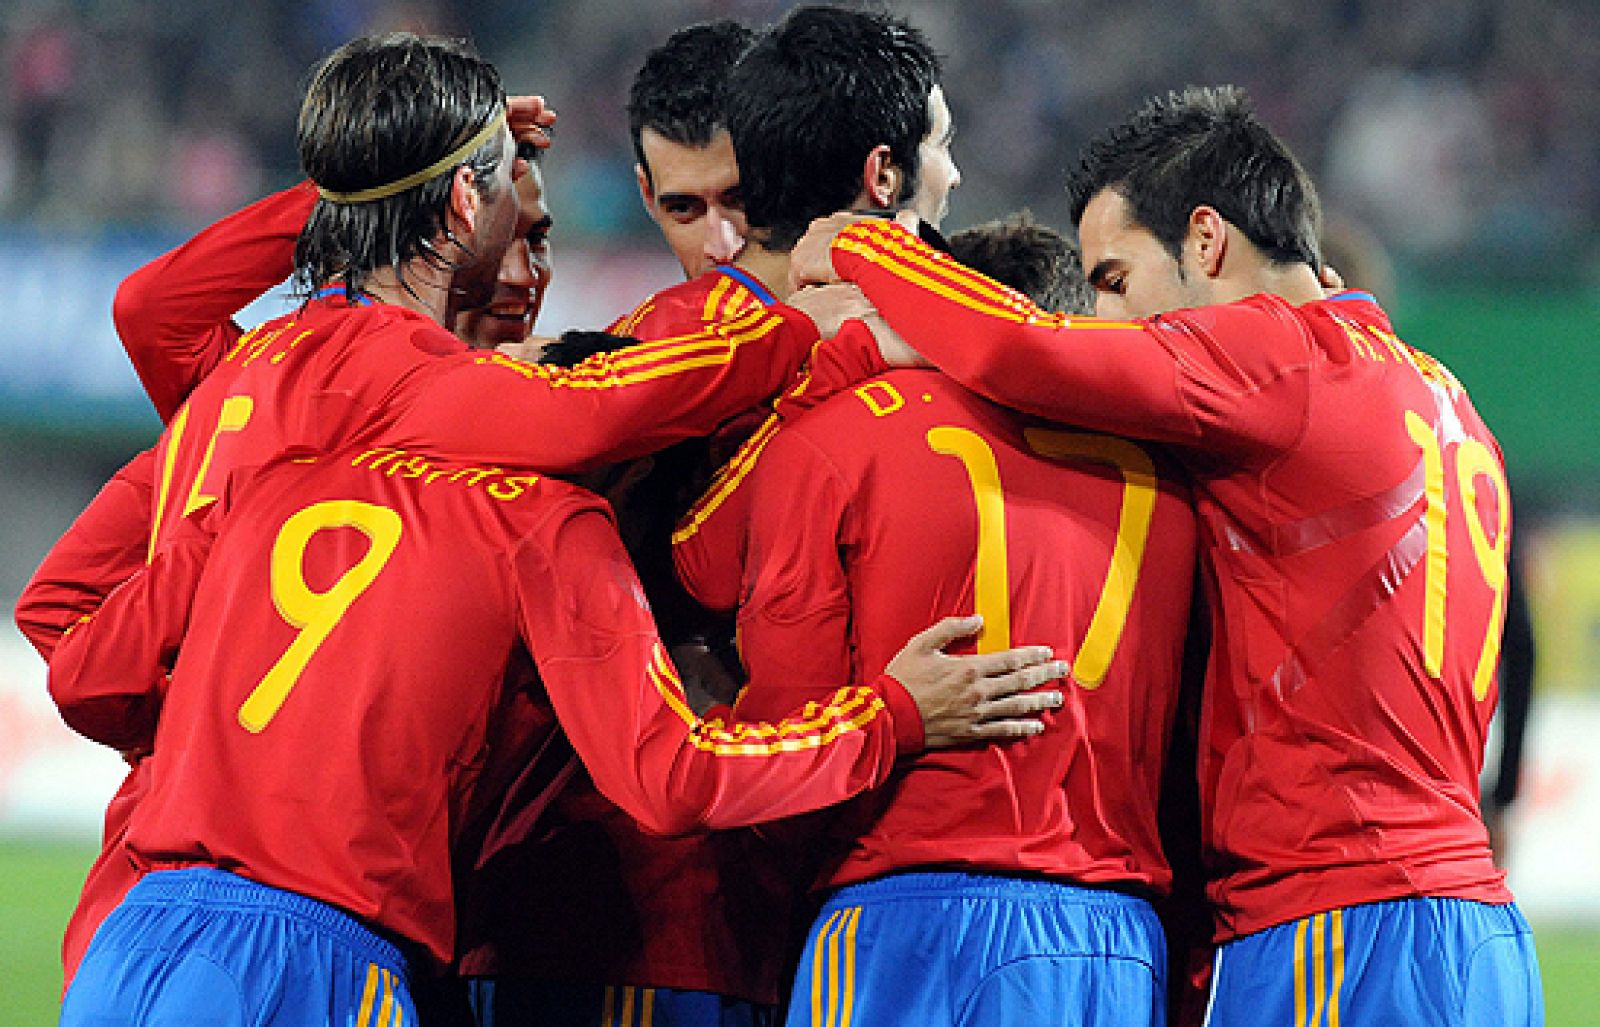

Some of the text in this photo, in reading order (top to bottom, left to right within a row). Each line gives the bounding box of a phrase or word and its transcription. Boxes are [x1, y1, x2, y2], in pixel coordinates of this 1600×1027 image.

[237, 499, 403, 734] 9
[926, 426, 1158, 690] 17
[1404, 409, 1508, 702] 19
